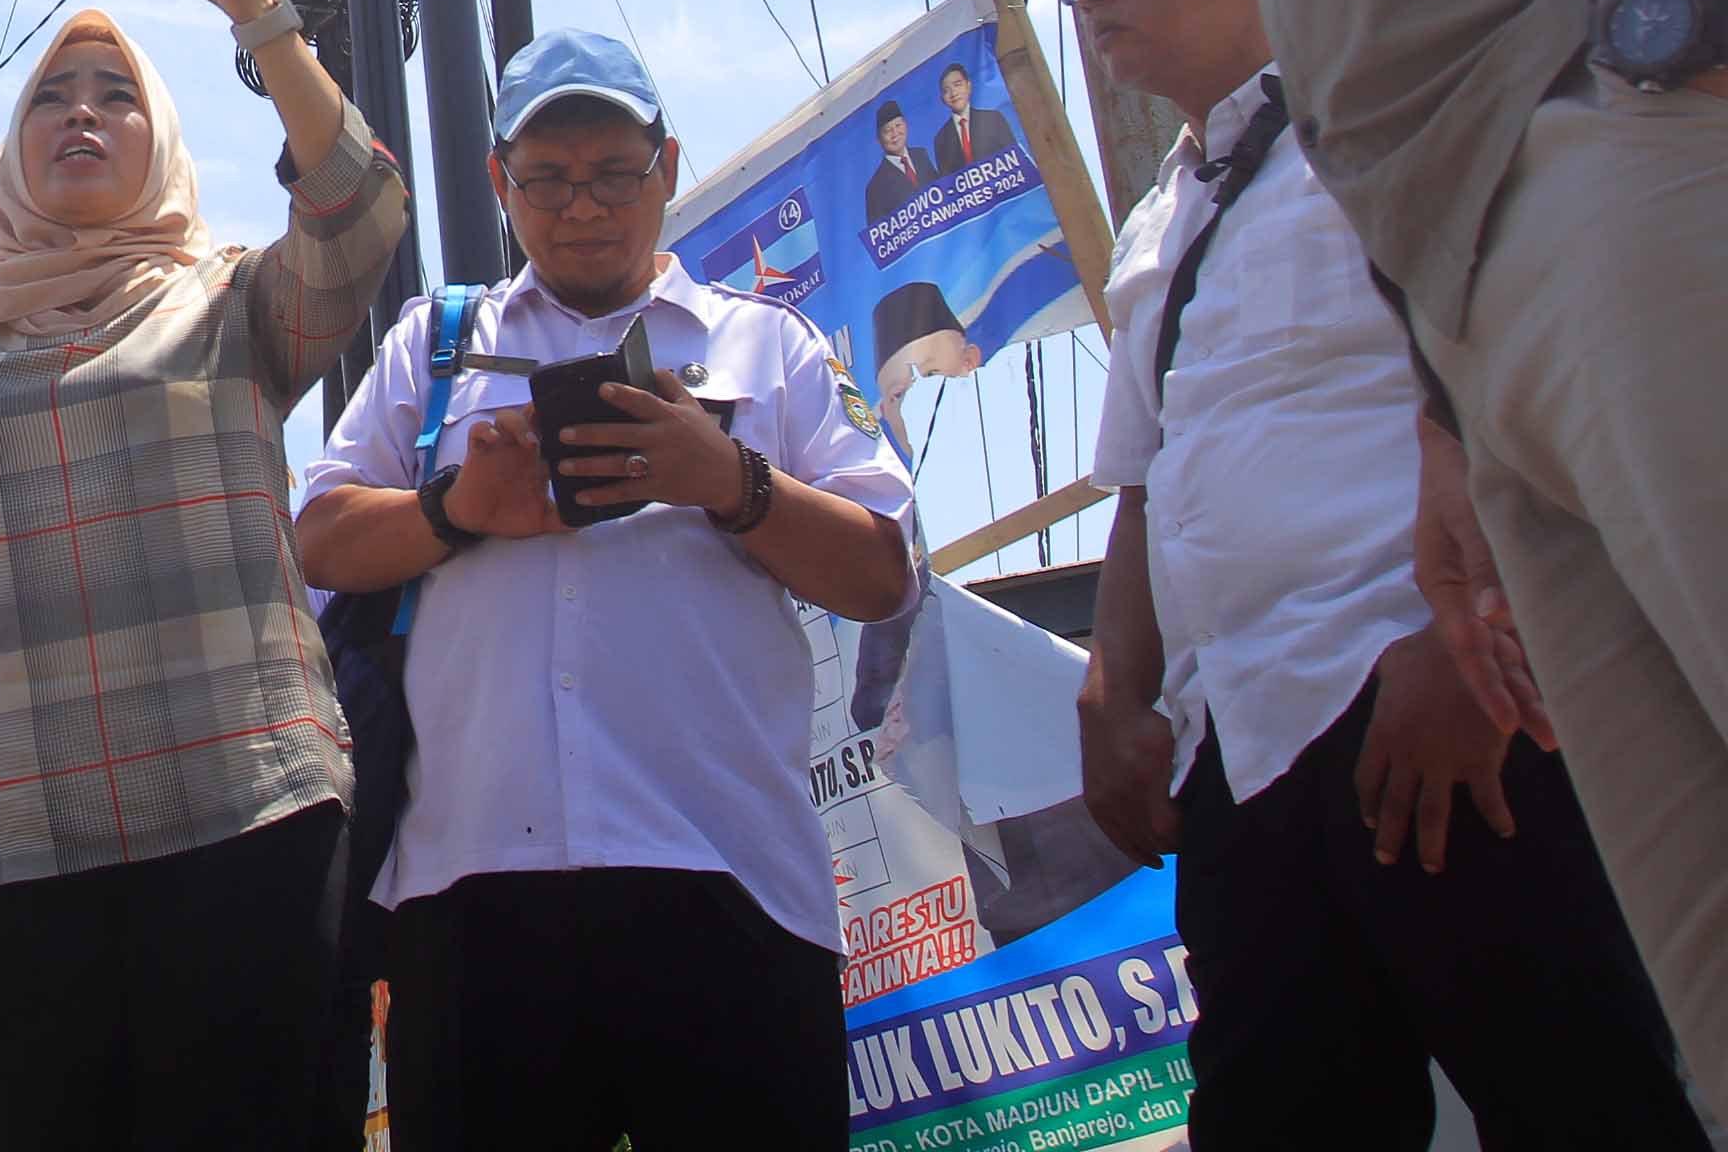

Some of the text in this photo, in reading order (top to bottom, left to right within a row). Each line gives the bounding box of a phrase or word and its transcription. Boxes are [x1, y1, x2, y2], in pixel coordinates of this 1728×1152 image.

[781, 204, 799, 225] 14
[869, 187, 943, 246] PRABOWO
[956, 150, 1020, 193] GIBRAN
[878, 170, 1025, 259] CAPRES CAWAPRES 2024
[810, 756, 843, 807] ITO,
[869, 875, 966, 951] RESTU
[921, 975, 1126, 1091] LUKITO,
[915, 1117, 984, 1151] KOTA
[985, 1089, 1080, 1132] MADIUN
[1086, 1068, 1164, 1105] DAPIL
[1027, 1113, 1135, 1151] Banjarejo,
[1138, 1098, 1182, 1123] dan
